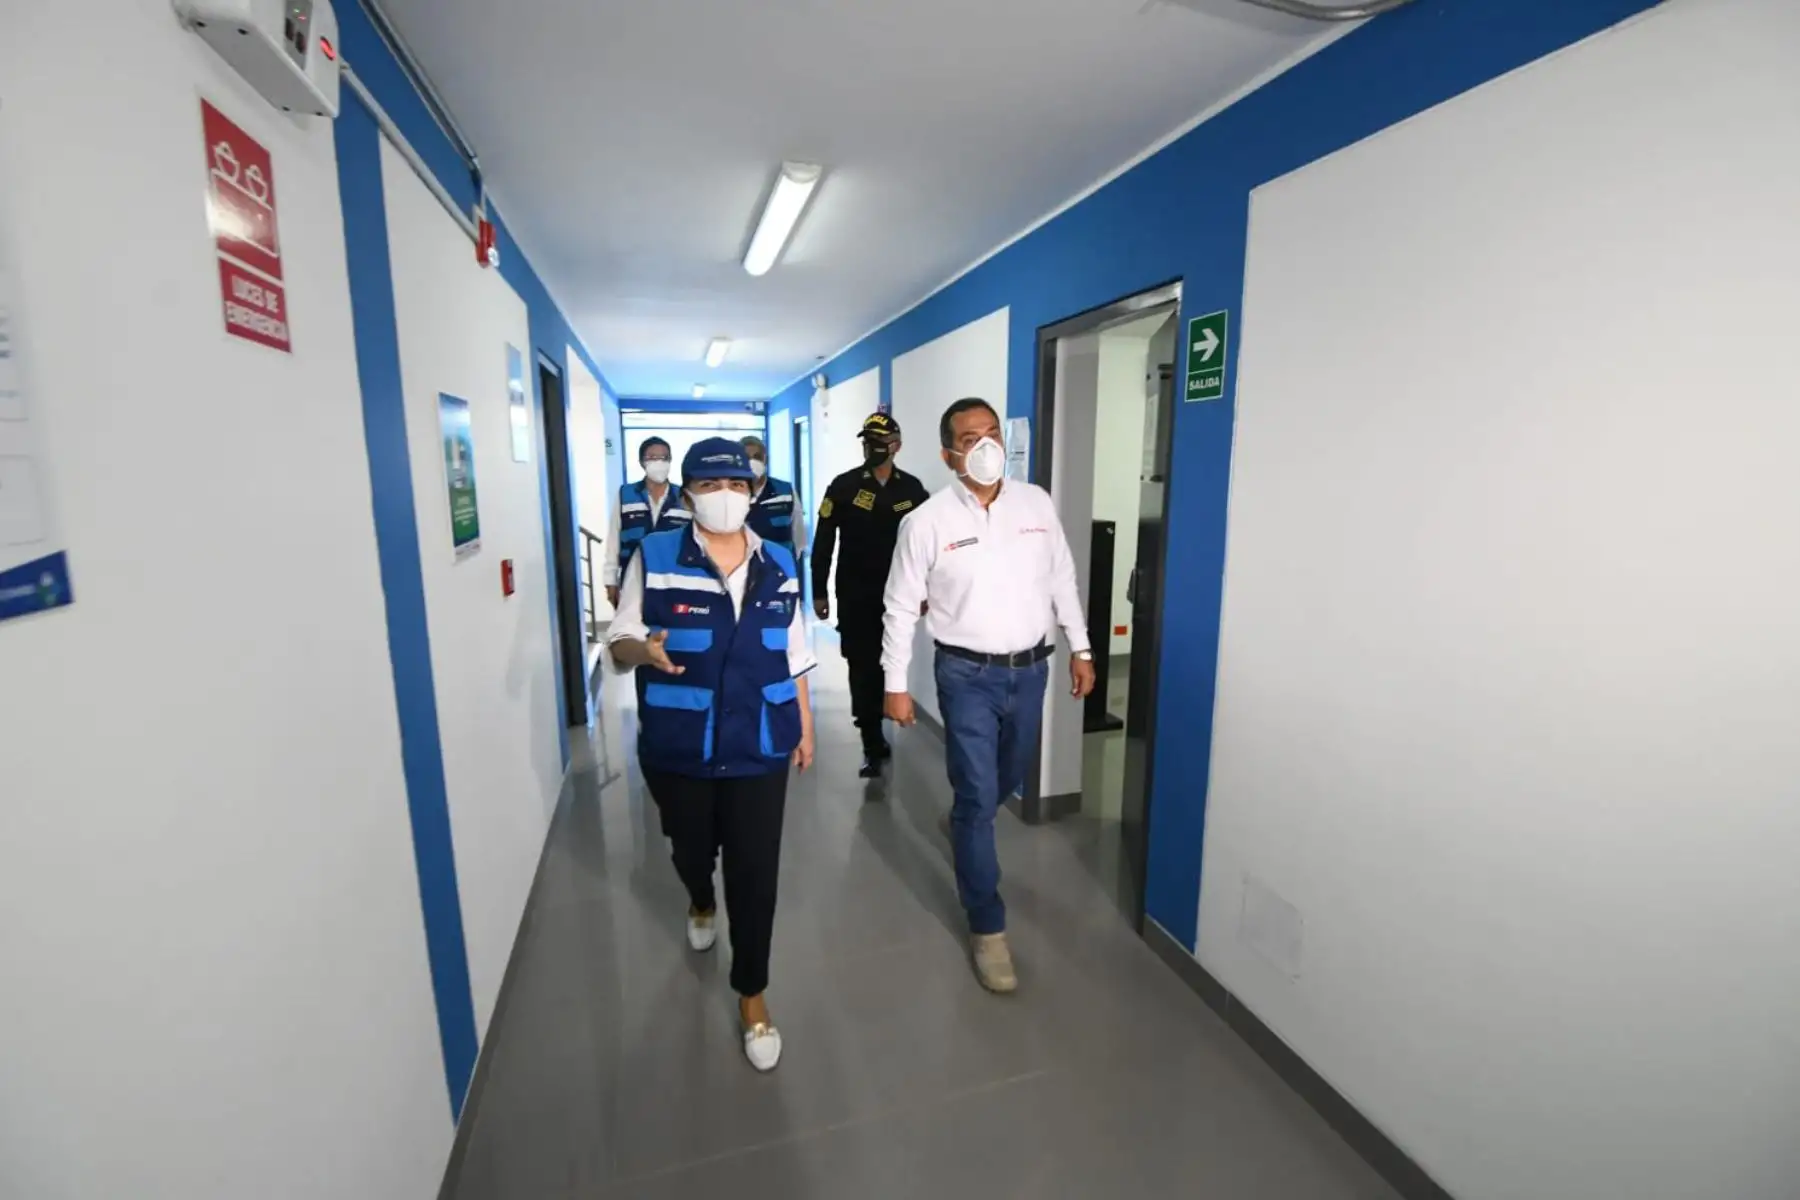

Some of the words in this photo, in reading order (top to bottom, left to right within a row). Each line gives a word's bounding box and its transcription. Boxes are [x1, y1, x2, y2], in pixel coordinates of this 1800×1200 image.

[231, 274, 265, 308] LUCES
[265, 290, 279, 314] DE
[1188, 376, 1220, 391] SALIDA
